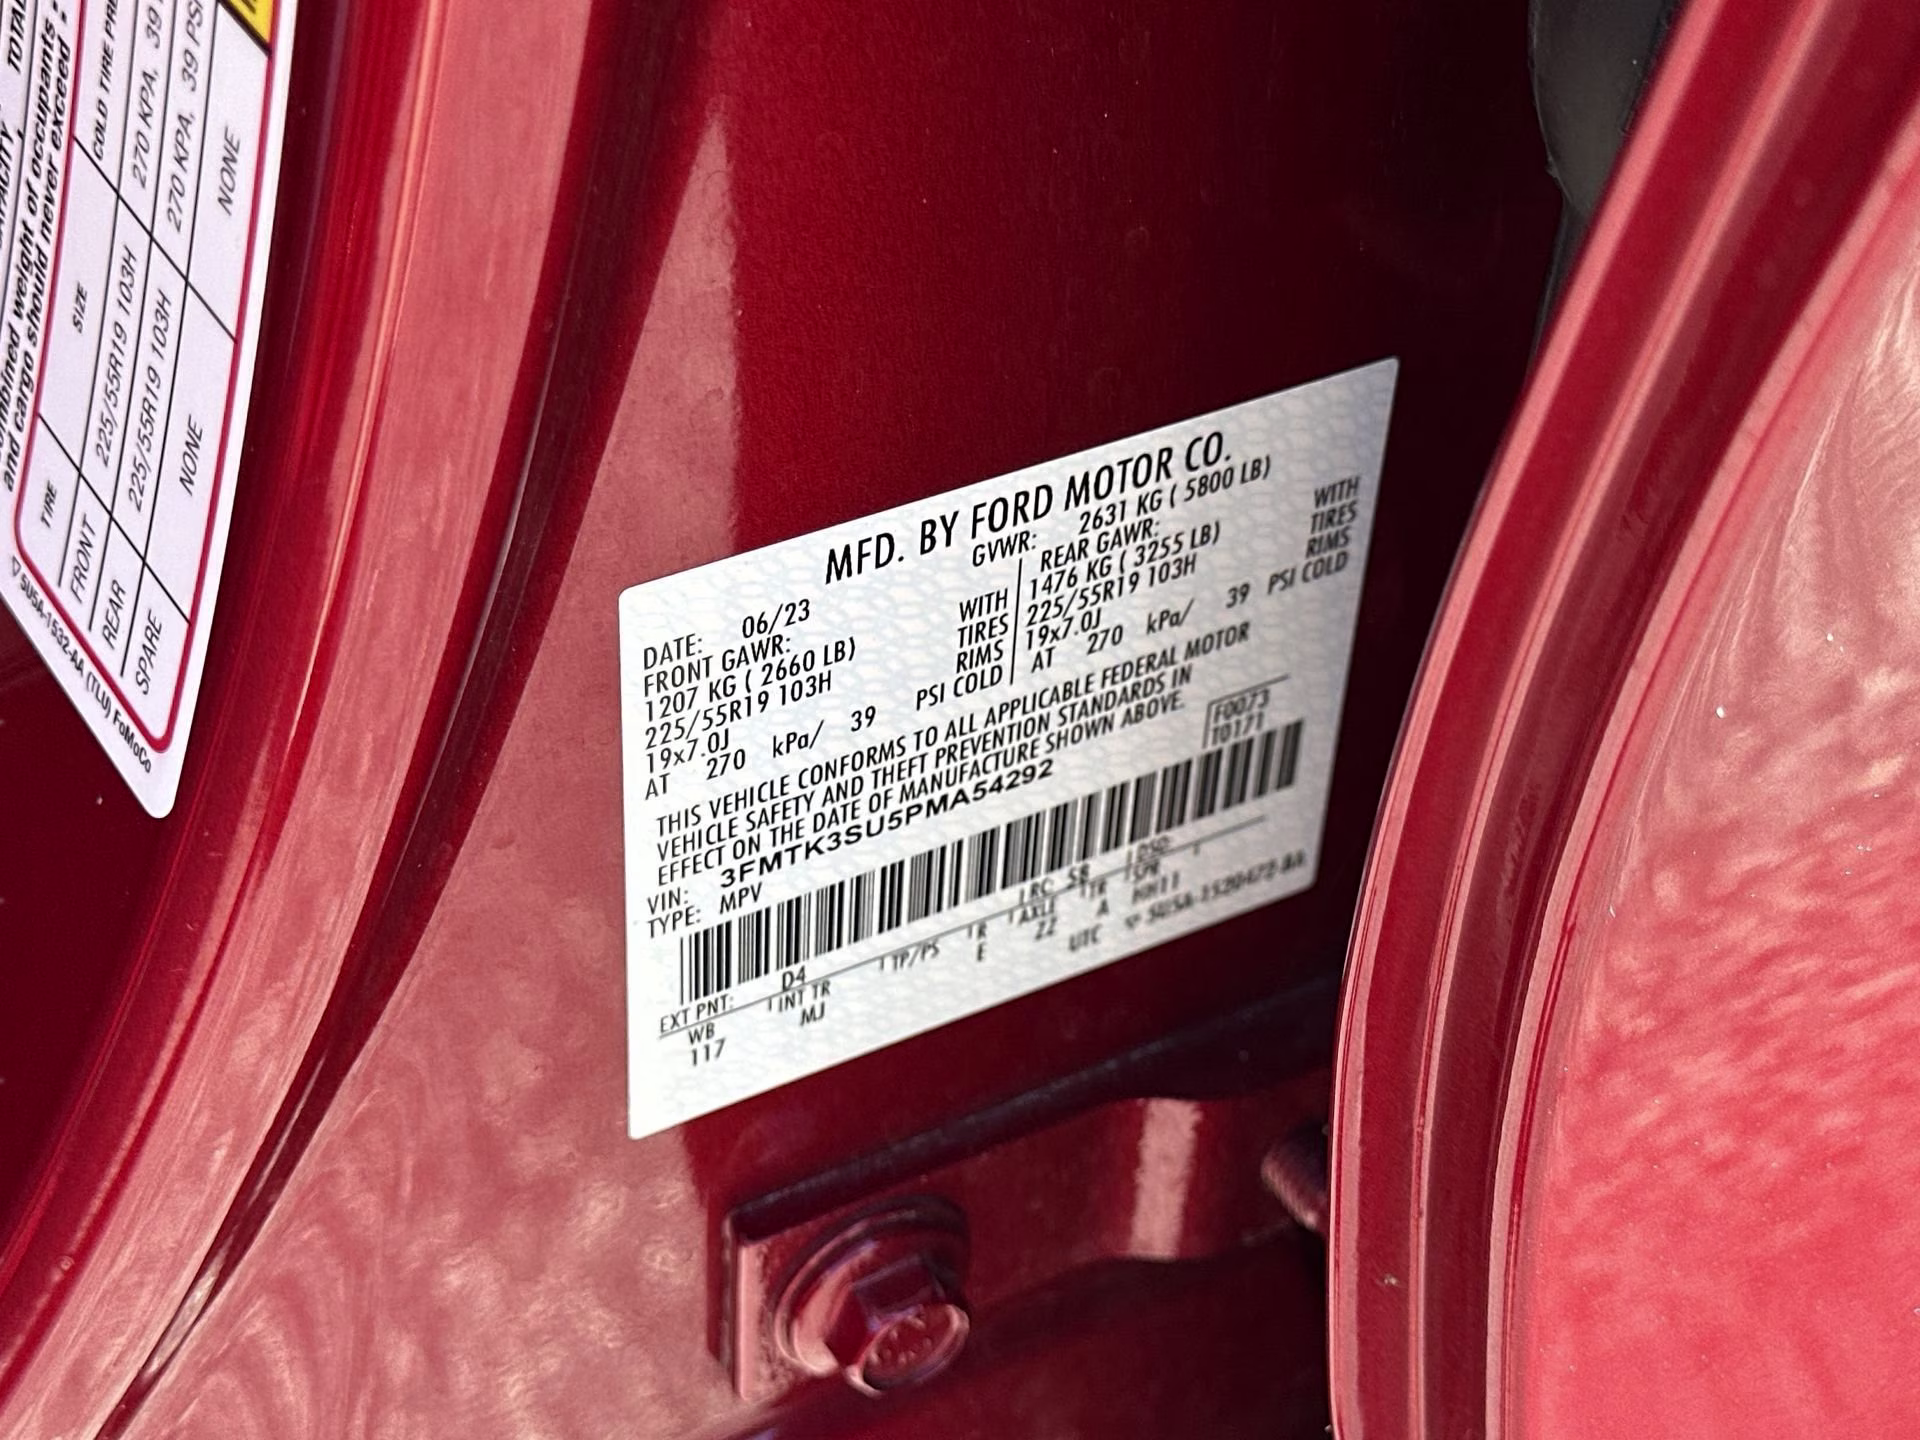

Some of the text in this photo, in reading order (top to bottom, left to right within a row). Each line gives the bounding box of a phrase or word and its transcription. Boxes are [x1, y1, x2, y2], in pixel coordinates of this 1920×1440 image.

[31, 18, 55, 179] occupants
[100, 40, 114, 94] TIRE
[131, 130, 152, 189] 270
[144, 6, 162, 49] 39
[93, 99, 108, 161] COLD
[166, 175, 187, 234] 270
[181, 49, 199, 92] 39
[216, 126, 241, 216] NONE
[27, 177, 39, 217] of
[4, 431, 20, 492] and
[14, 350, 35, 433] cargo
[27, 242, 48, 347] should
[40, 153, 59, 245] never
[51, 34, 71, 151] exceed
[13, 219, 35, 320] weight
[72, 280, 88, 334] SIZE
[95, 245, 138, 468] 225/55R19 103H
[128, 288, 172, 512] 225/55R19 103H
[39, 480, 58, 529] TIRE
[178, 414, 203, 497] NONE
[825, 431, 1231, 585] MFD. BY FORD MOTOR CO.
[972, 530, 1037, 567] GVWR:
[1079, 500, 1127, 535] 2631
[1136, 489, 1162, 516] KG
[1184, 467, 1234, 503] 5800
[1240, 455, 1271, 485] LB)
[70, 513, 96, 604] FRONT
[1026, 526, 1351, 650] 19x7.0J RIMS
[1027, 502, 1357, 627] 225/55R19 103H TIRES
[1030, 566, 1077, 600] 1476
[1086, 555, 1112, 583] KG
[1134, 532, 1183, 567] 3255
[1189, 521, 1221, 549] LB)
[1314, 476, 1360, 508] WITH
[1040, 518, 1160, 573] REAR GAWR:
[102, 579, 127, 649] REAR
[135, 608, 163, 695] SPARE
[643, 599, 811, 670] DATE: 06/23
[644, 634, 791, 697] FRONT GAWR:
[646, 686, 698, 722] 1207
[709, 675, 736, 703] KG
[761, 650, 815, 686] 2660
[823, 637, 856, 666] LB)
[959, 588, 1008, 622] WITH
[1031, 551, 1349, 673] AT 270 kPa/ 39 PSI COLD
[86, 671, 111, 718] (TLU)
[113, 708, 152, 773] FoMoCo
[645, 613, 1009, 749] 225/55R19 103H TIRES
[645, 665, 1003, 800] AT 270 kPa/ 39 PSI COLD
[647, 639, 1003, 774] 19x7.0J RIMS
[656, 621, 1250, 837] THIS VEHICLE CONFORMS TO ALL APPLICABLE FEDERAL MOTOR
[657, 666, 1192, 861] VEHICLE SAFETY AND THEFT PREVENTION STANDARDS IN
[658, 845, 725, 886] EFFECT
[733, 833, 761, 860] ON
[770, 818, 805, 847] THE
[813, 801, 861, 834] DATE
[869, 788, 894, 814] OF
[899, 737, 1041, 804] MANUFACTURE
[1046, 713, 1114, 753] SHOWN
[647, 758, 1055, 915] VIN: 3FMTK3SU5PMA54292
[647, 882, 763, 938] TYPE: MPV
[660, 1009, 690, 1033] EXT
[696, 993, 734, 1020] PNT:
[782, 965, 805, 992] D4
[688, 1022, 715, 1045] WB
[812, 980, 831, 1000] TR
[691, 1037, 725, 1066] 117
[800, 1001, 825, 1027] MJ
